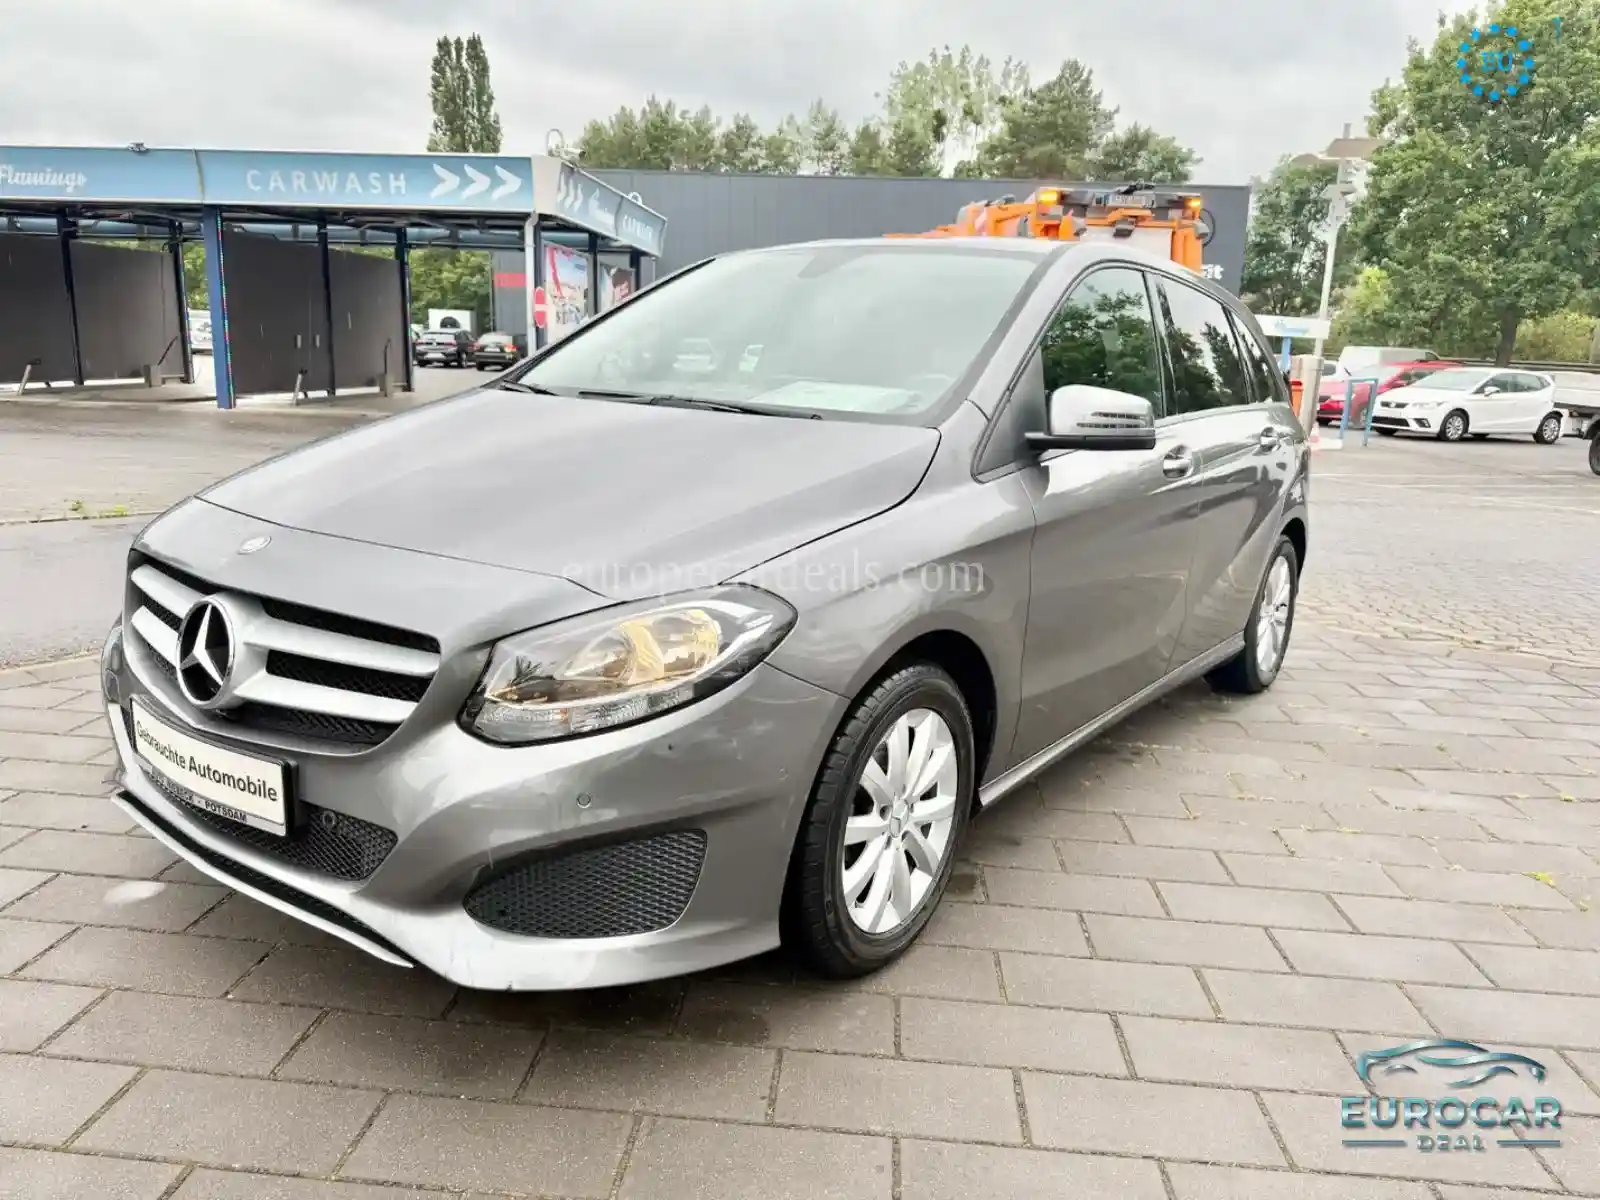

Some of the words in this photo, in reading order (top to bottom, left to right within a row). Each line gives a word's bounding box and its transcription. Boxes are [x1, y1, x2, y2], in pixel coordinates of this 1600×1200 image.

[246, 169, 407, 195] CARWASH
[137, 721, 187, 770] Gebrauchte
[188, 756, 278, 802] Automobile
[204, 800, 248, 822] POTSDAM
